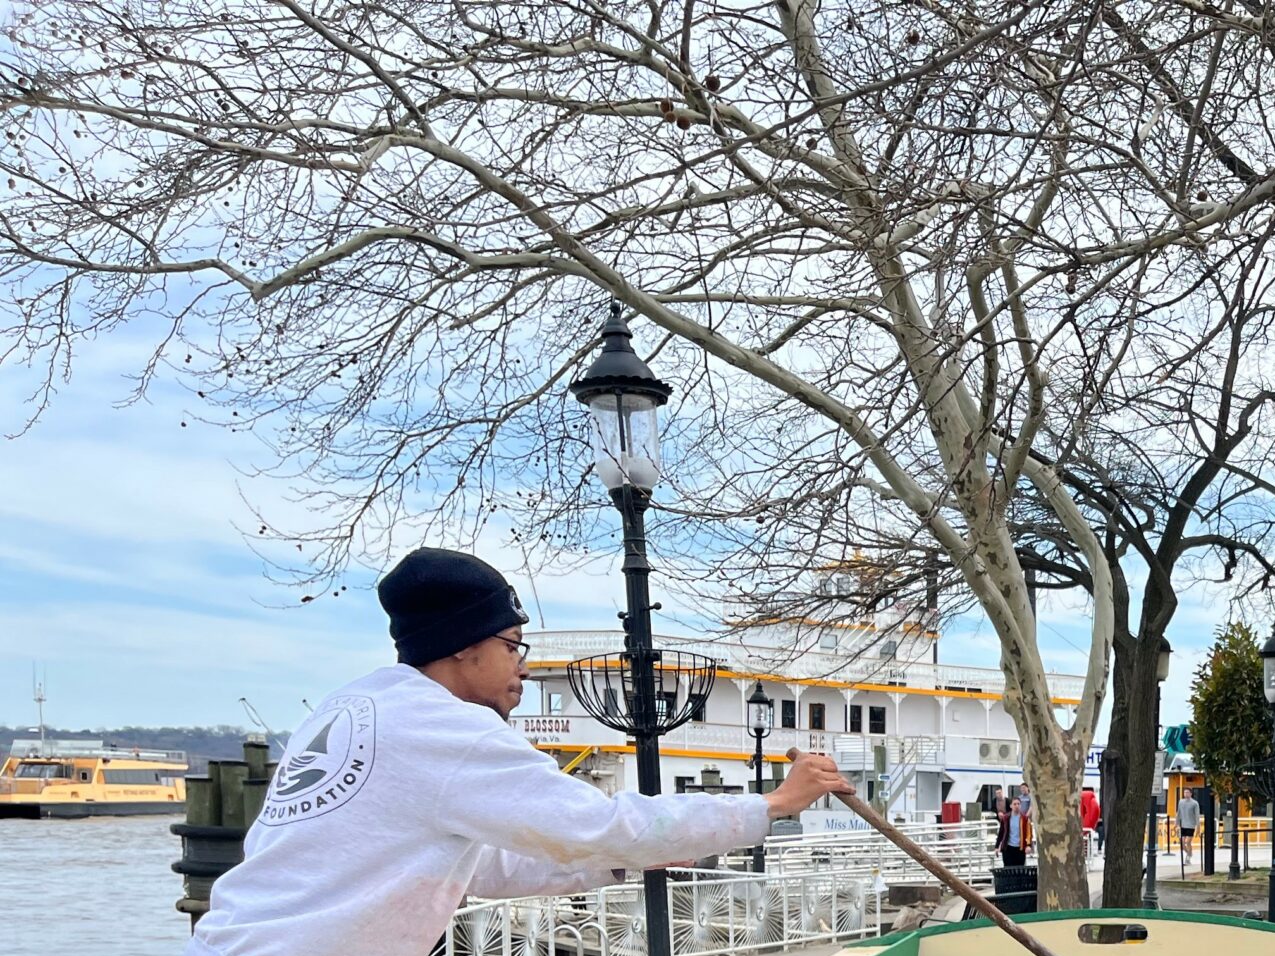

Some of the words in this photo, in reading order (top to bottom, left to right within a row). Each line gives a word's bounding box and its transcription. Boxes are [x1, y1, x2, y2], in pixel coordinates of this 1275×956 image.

[524, 719, 571, 733] BLOSSOM
[263, 759, 365, 819] FOUNDATION
[825, 818, 847, 830] Miss
